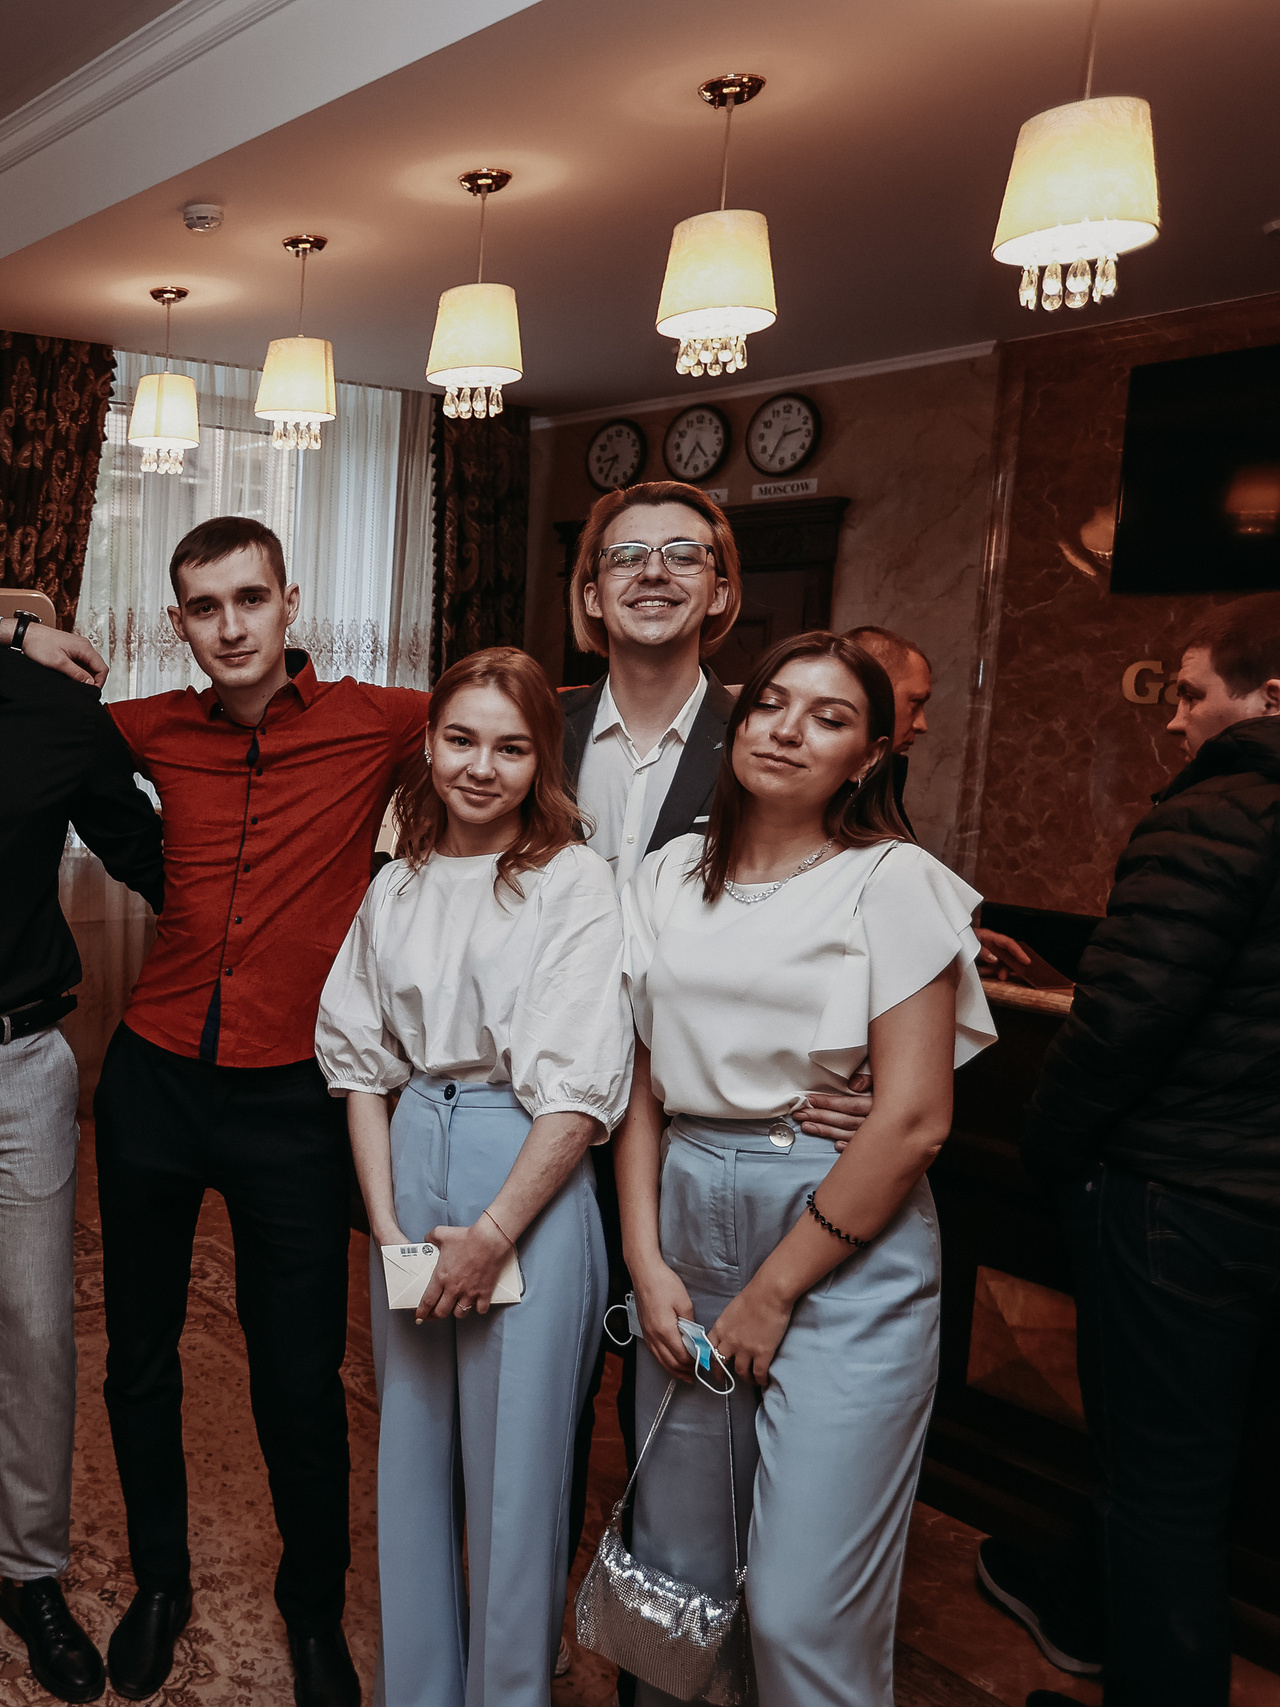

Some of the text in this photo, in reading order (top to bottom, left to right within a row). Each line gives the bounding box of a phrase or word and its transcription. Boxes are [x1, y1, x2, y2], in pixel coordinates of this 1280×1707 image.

[772, 408, 780, 418] 11
[783, 404, 792, 414] 12
[797, 407, 801, 416] 1
[762, 420, 772, 429] 10
[802, 416, 809, 425] 2
[759, 432, 765, 442] 9
[804, 428, 811, 438] 3
[760, 445, 767, 454] 8
[799, 442, 806, 450] 4
[778, 456, 785, 466] 6
[790, 452, 797, 461] 5
[758, 481, 811, 496] MOSCOW
